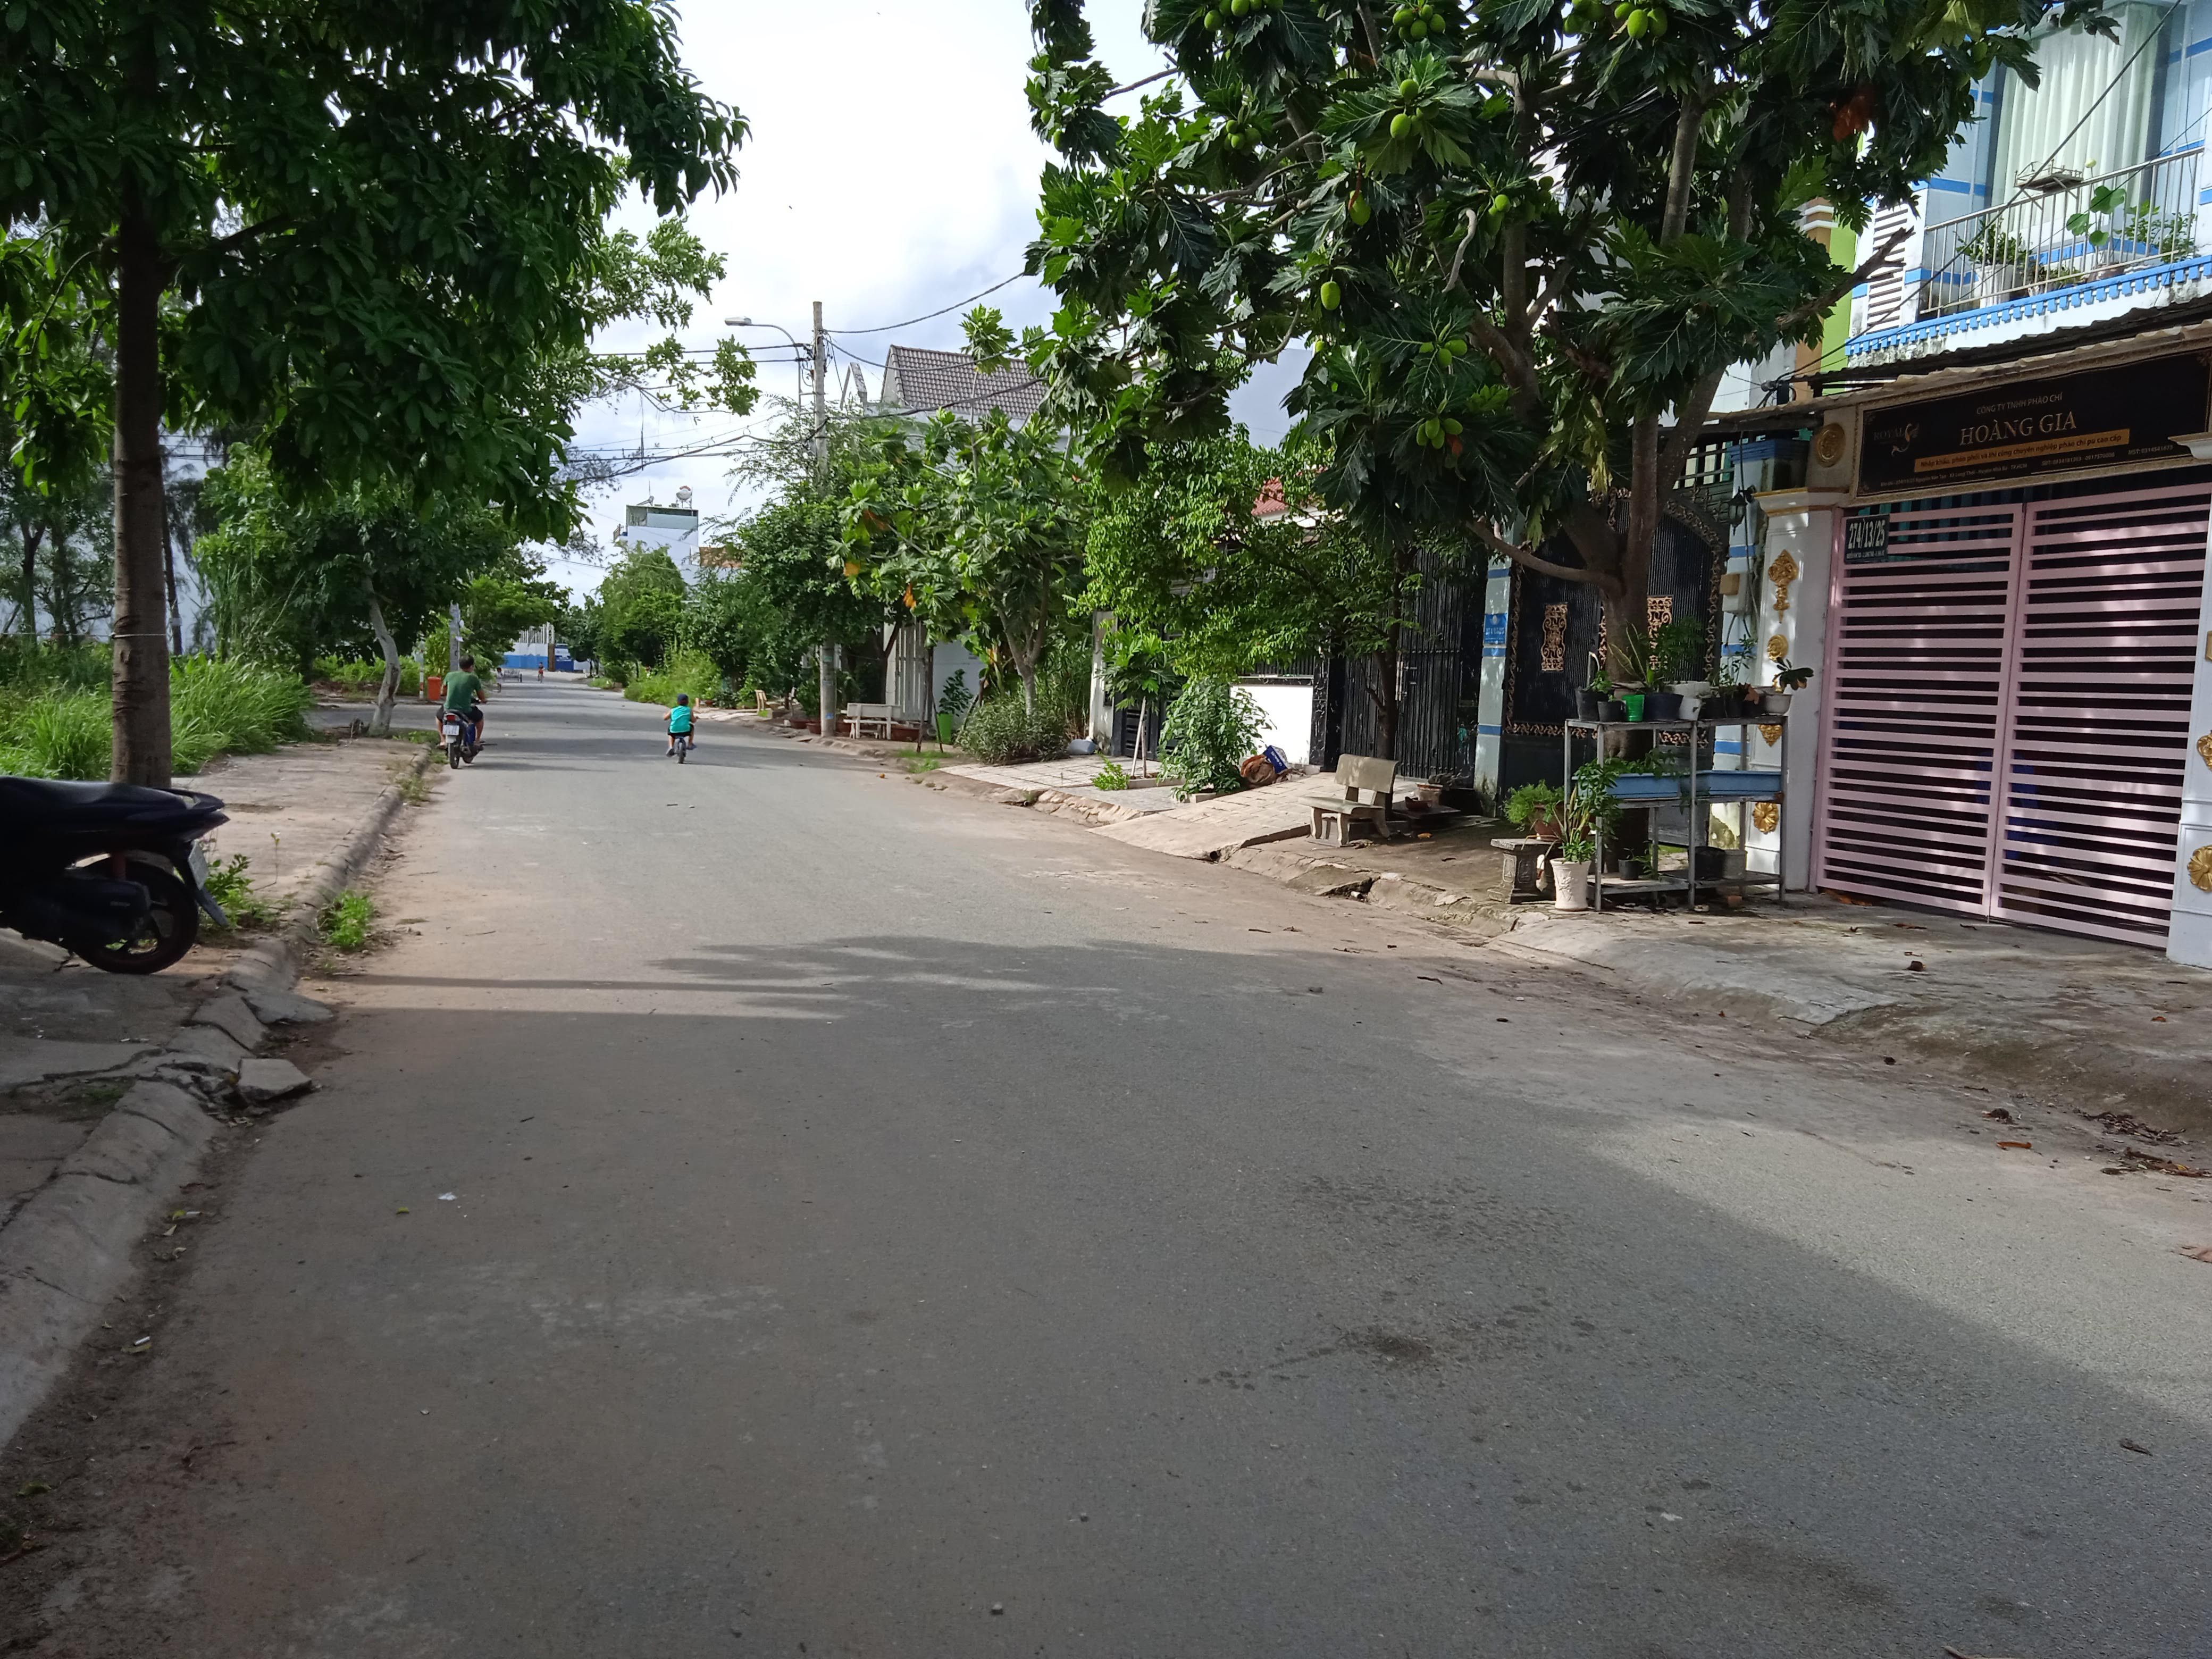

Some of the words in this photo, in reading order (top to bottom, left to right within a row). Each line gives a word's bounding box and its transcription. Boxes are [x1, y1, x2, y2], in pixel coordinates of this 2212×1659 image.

[1976, 404, 1996, 415] CÔNG
[2007, 399, 2026, 409] TNHH
[1959, 417, 2033, 446] HOÀNG
[2039, 411, 2076, 433] GIA
[2013, 446, 2034, 455] chuyên
[2035, 443, 2057, 453] nghiệp
[2109, 433, 2122, 442] cấp
[1848, 520, 1886, 549] 274/13/25
